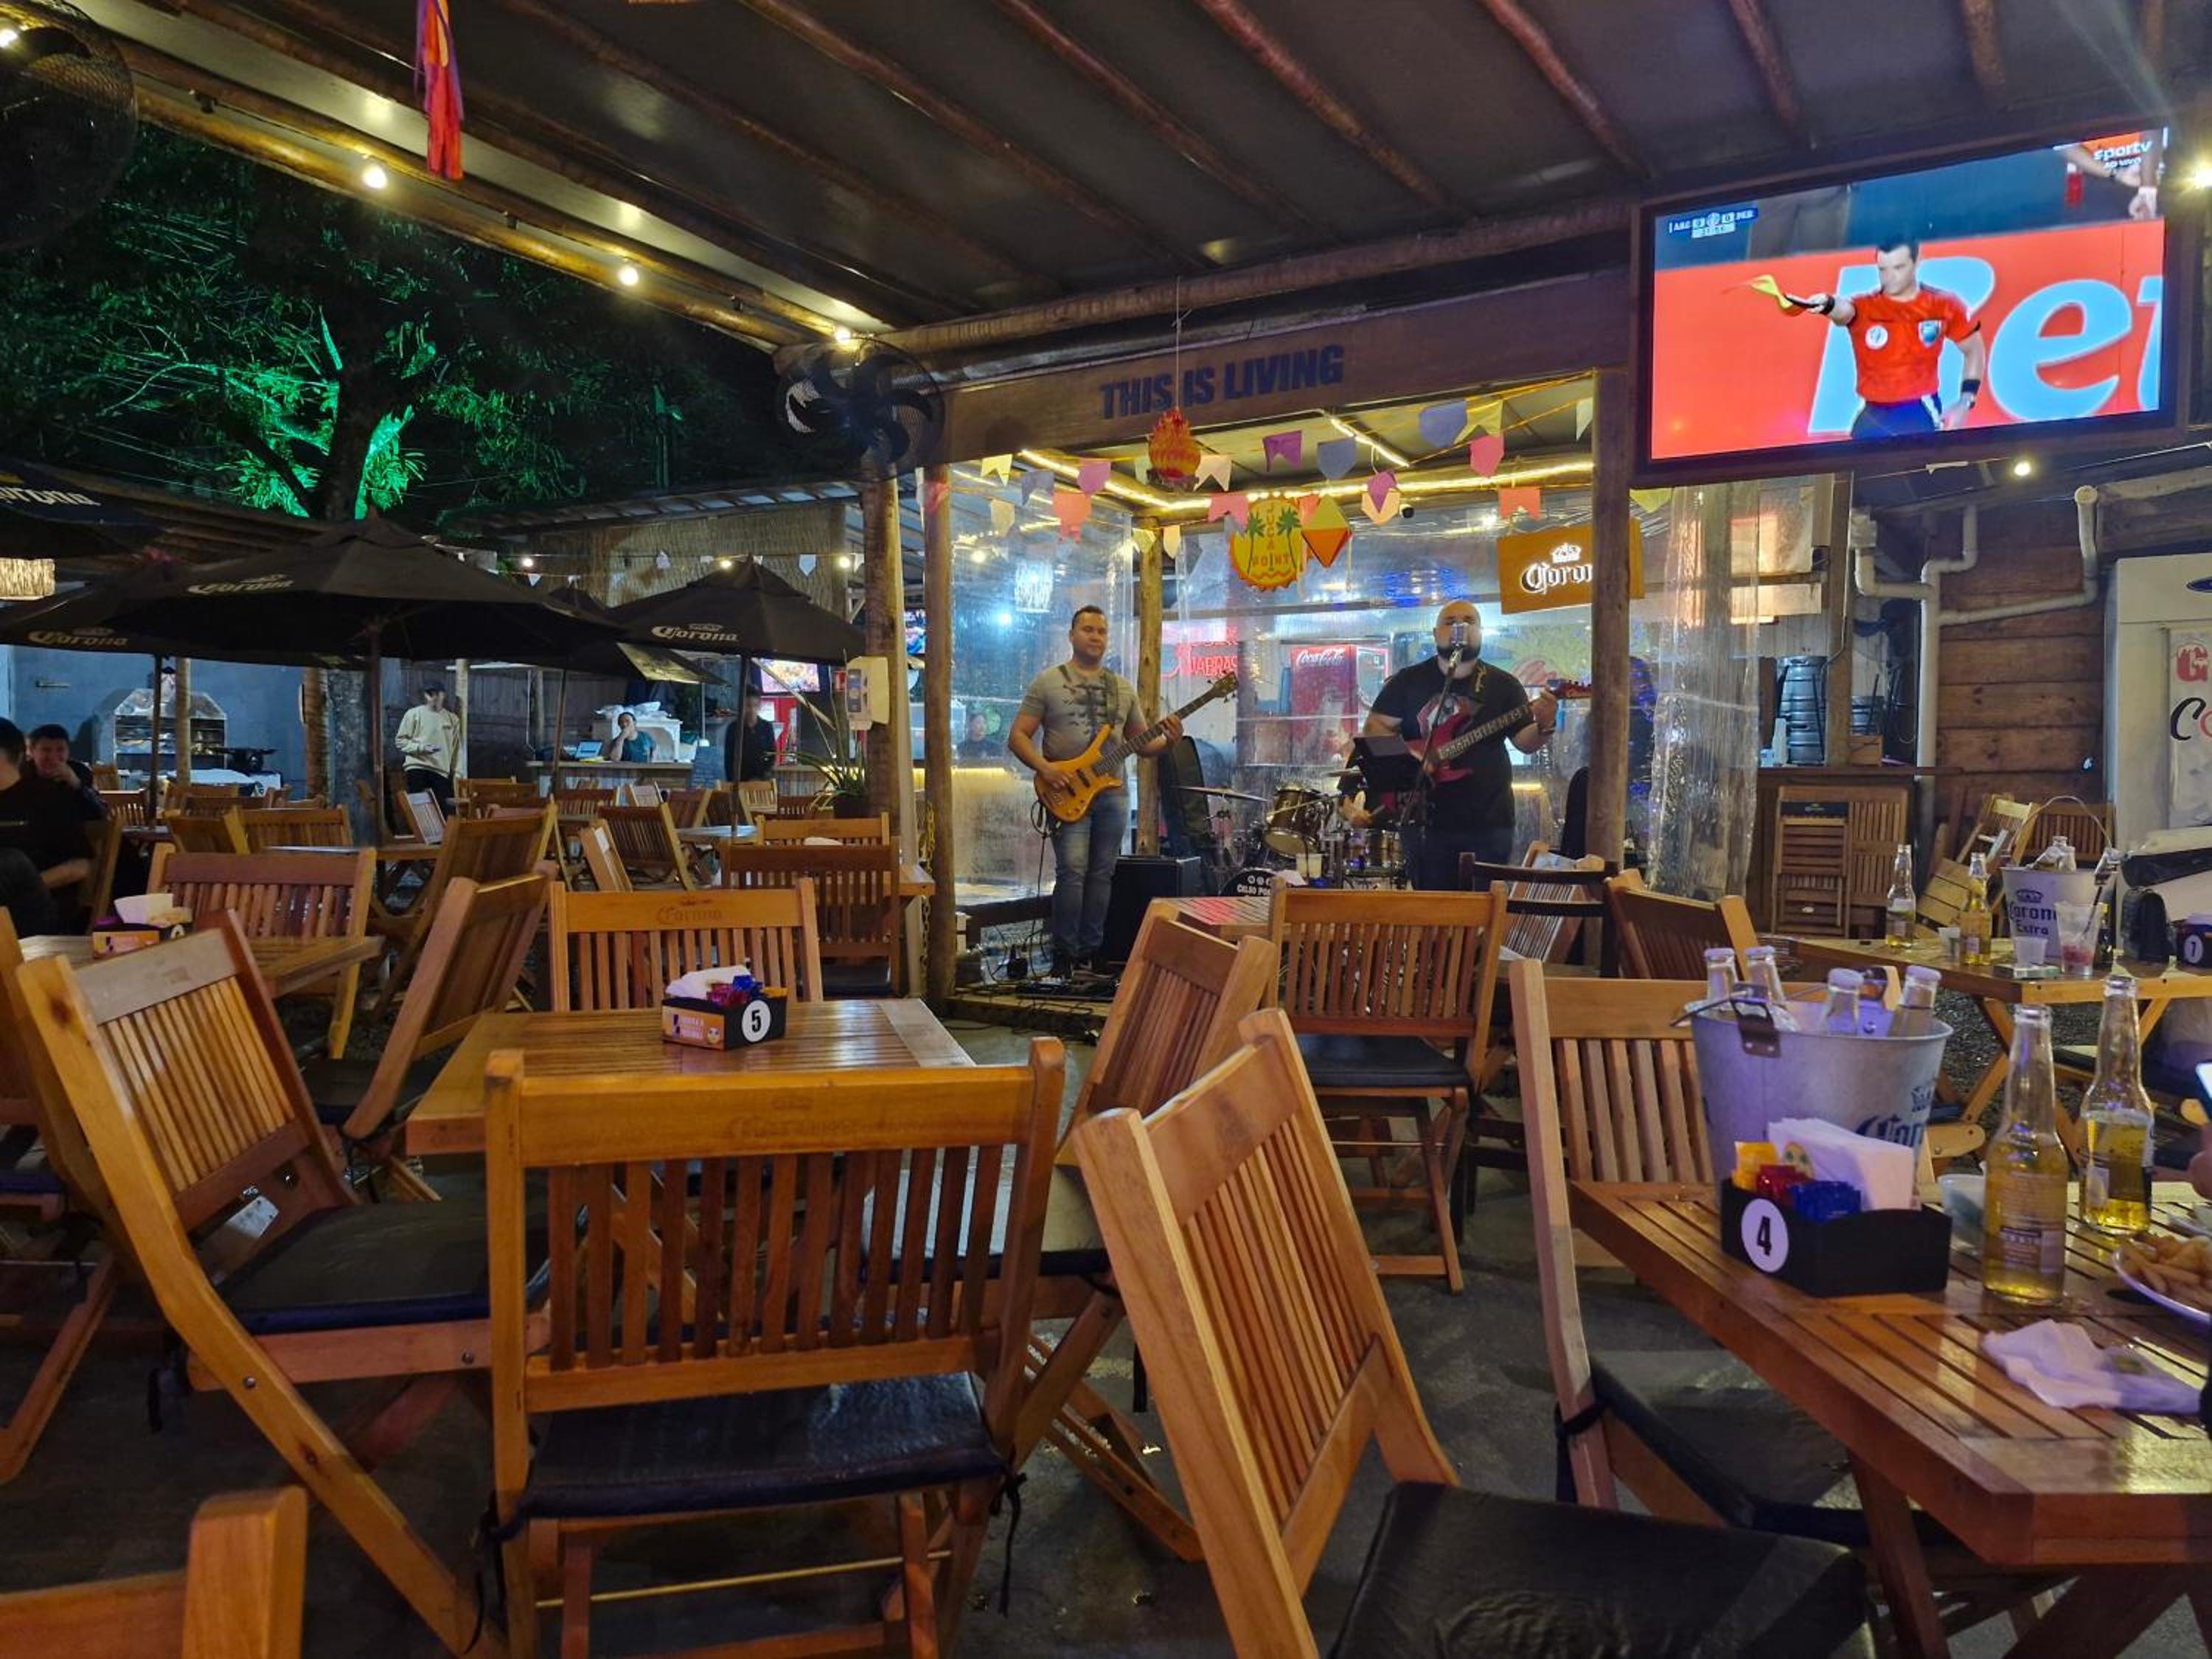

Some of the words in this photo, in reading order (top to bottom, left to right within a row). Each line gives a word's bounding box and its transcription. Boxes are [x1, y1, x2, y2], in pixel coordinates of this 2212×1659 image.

[1099, 373, 1172, 419] THIS
[1183, 365, 1214, 406] IS
[1223, 344, 1344, 401] LIVING
[0, 487, 101, 505] orona
[751, 1009, 762, 1033] 5
[1757, 1216, 1772, 1256] 4
